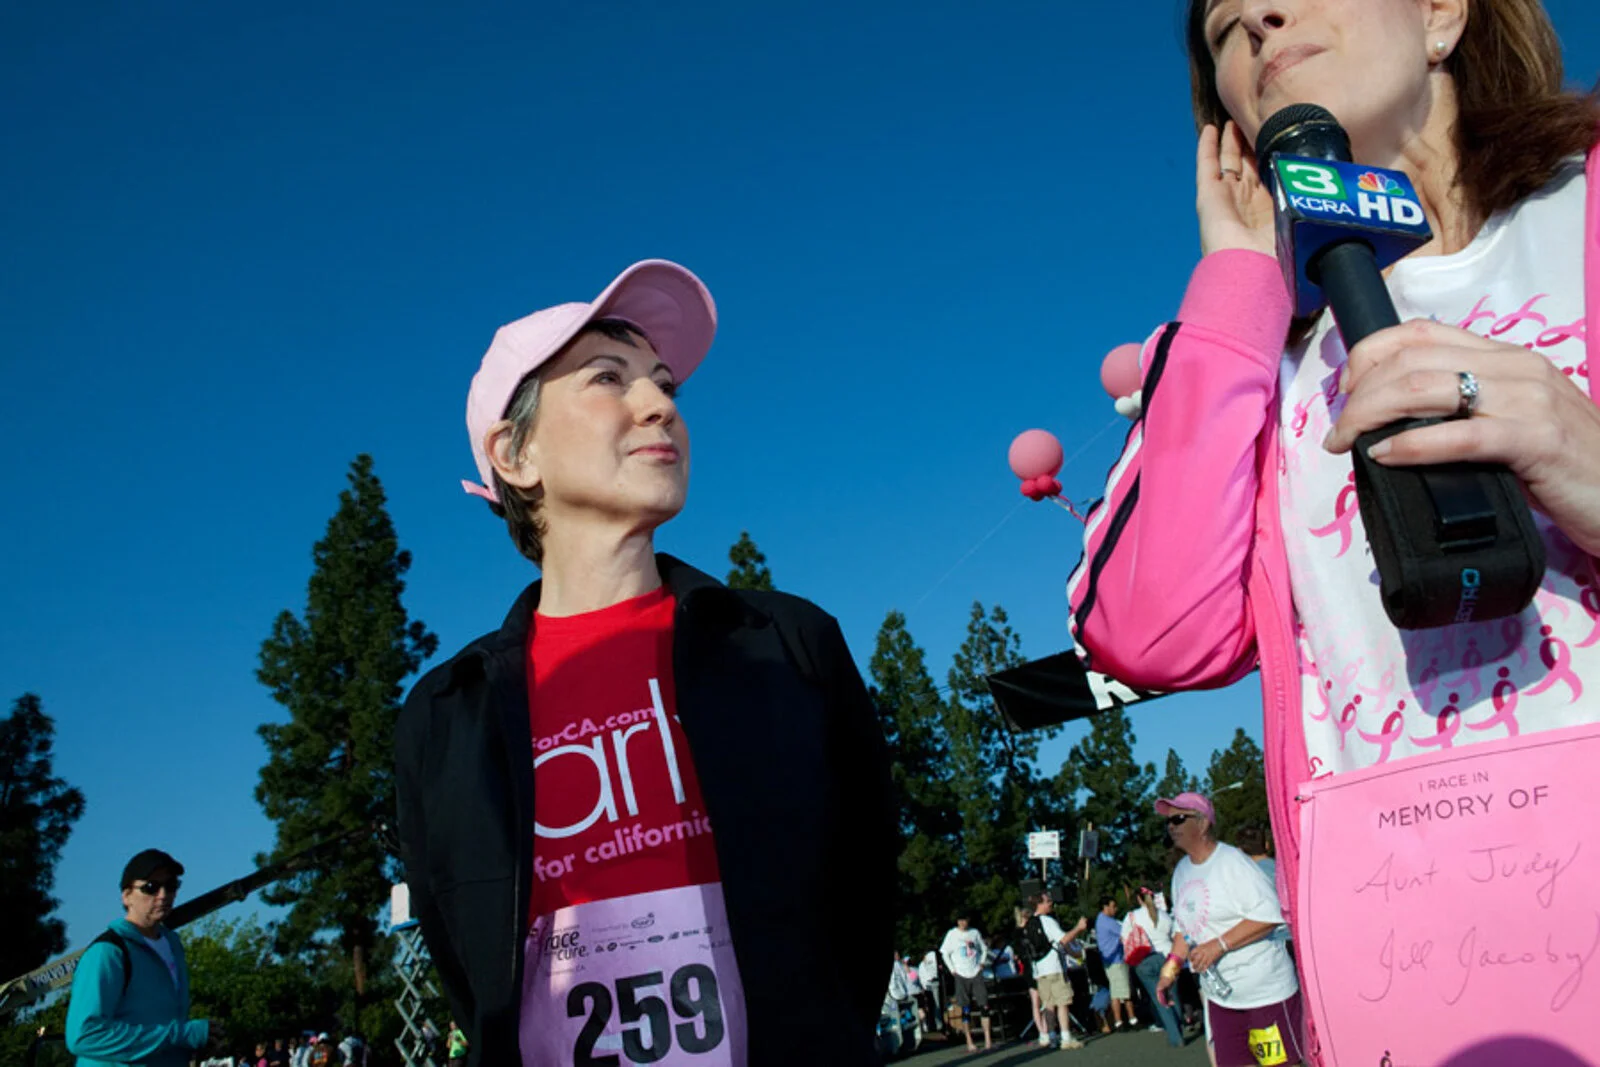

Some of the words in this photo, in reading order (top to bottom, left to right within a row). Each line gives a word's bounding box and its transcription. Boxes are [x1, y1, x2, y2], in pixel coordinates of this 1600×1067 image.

[1286, 164, 1338, 195] 3
[1290, 195, 1356, 217] KCRA
[1357, 192, 1424, 226] HD
[1428, 775, 1469, 791] RACE
[1473, 771, 1489, 783] IN
[1378, 794, 1494, 830] MEMORY
[1508, 785, 1550, 810] OF
[534, 856, 576, 882] for
[1354, 852, 1438, 903] Aunt
[1467, 842, 1581, 909] Judy
[544, 931, 580, 952] race
[567, 963, 725, 1067] 259
